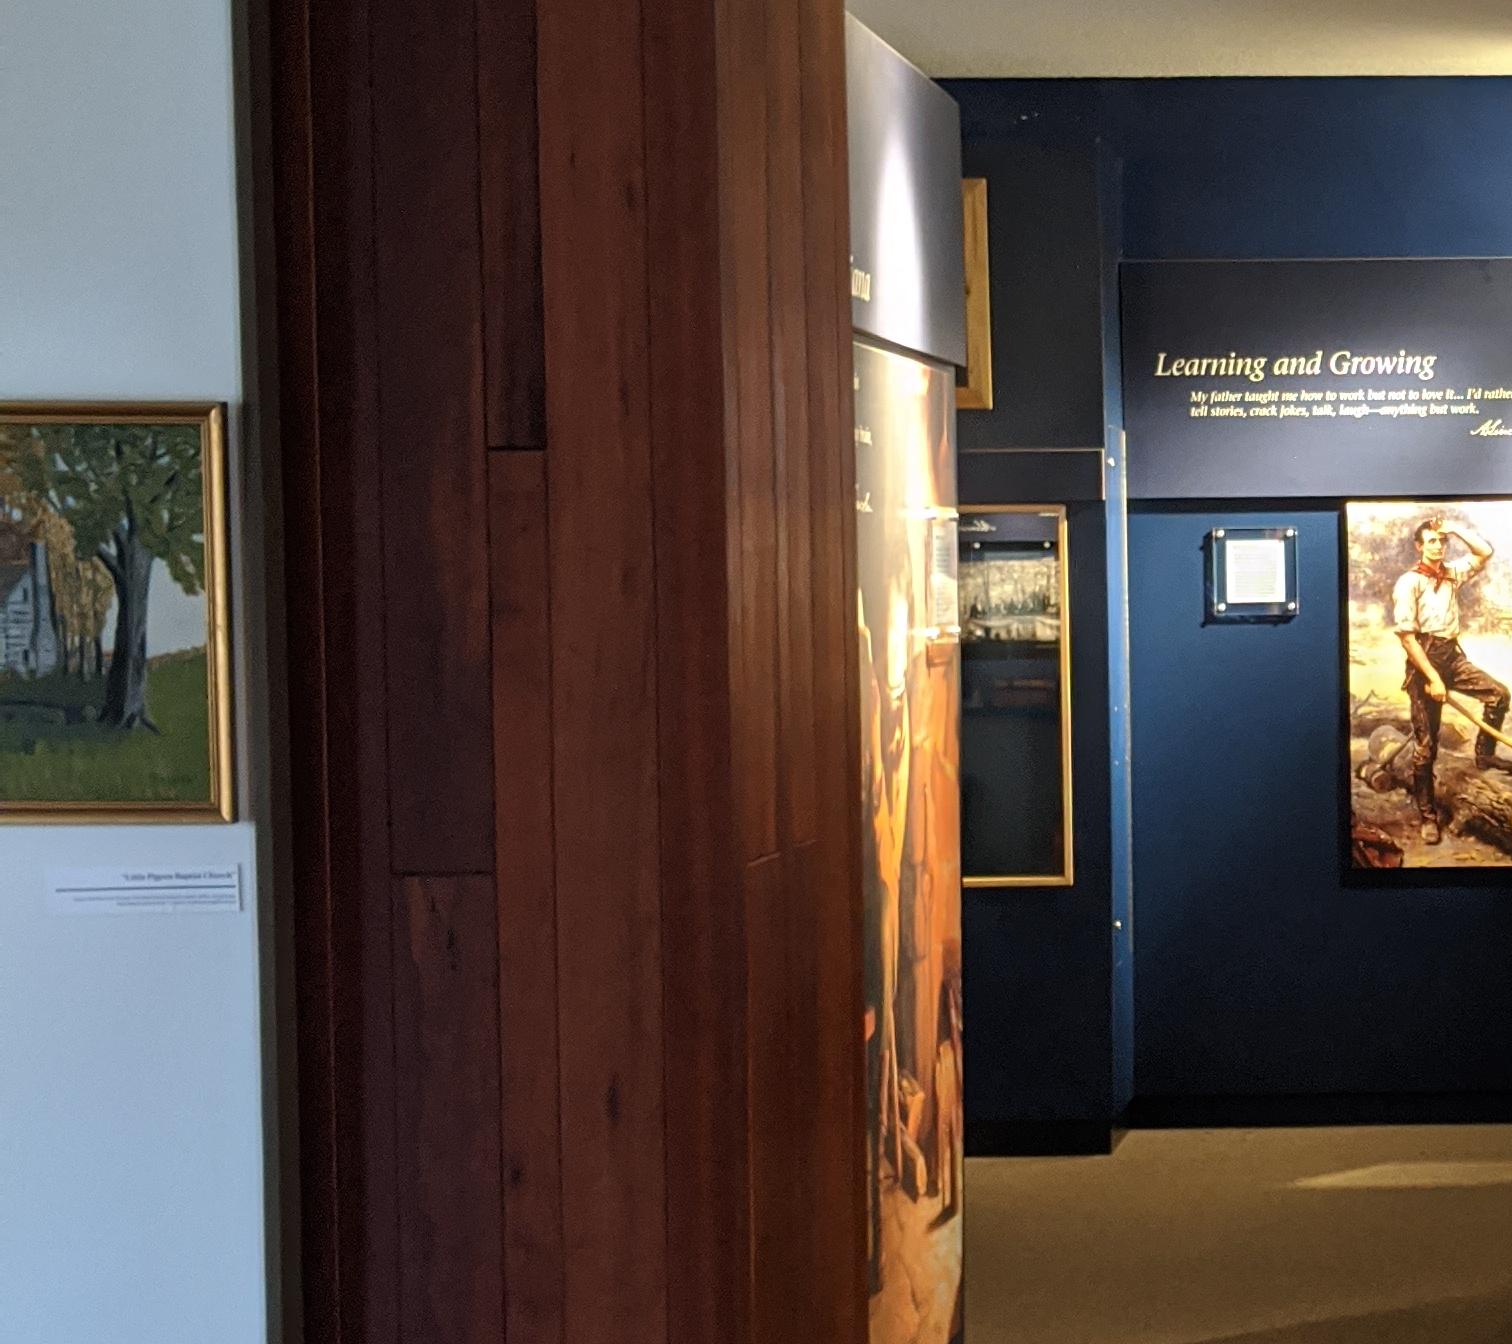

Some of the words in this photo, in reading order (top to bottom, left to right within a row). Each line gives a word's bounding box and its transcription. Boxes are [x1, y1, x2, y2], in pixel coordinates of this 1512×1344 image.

[1154, 352, 1268, 382] Learning
[1273, 350, 1323, 376] and
[1329, 349, 1438, 380] Growing
[1190, 391, 1208, 404] My
[1210, 390, 1243, 404] father
[1244, 390, 1280, 404] taught
[1281, 392, 1298, 402] me
[1301, 389, 1323, 402] how
[1325, 390, 1337, 401] to
[1339, 388, 1366, 401] work
[1367, 388, 1386, 401] but
[1387, 389, 1406, 401] not
[1408, 389, 1419, 401] to
[1421, 388, 1443, 401] love
[1190, 404, 1208, 417] tell
[1249, 404, 1277, 417] crack
[1430, 403, 1448, 415] but
